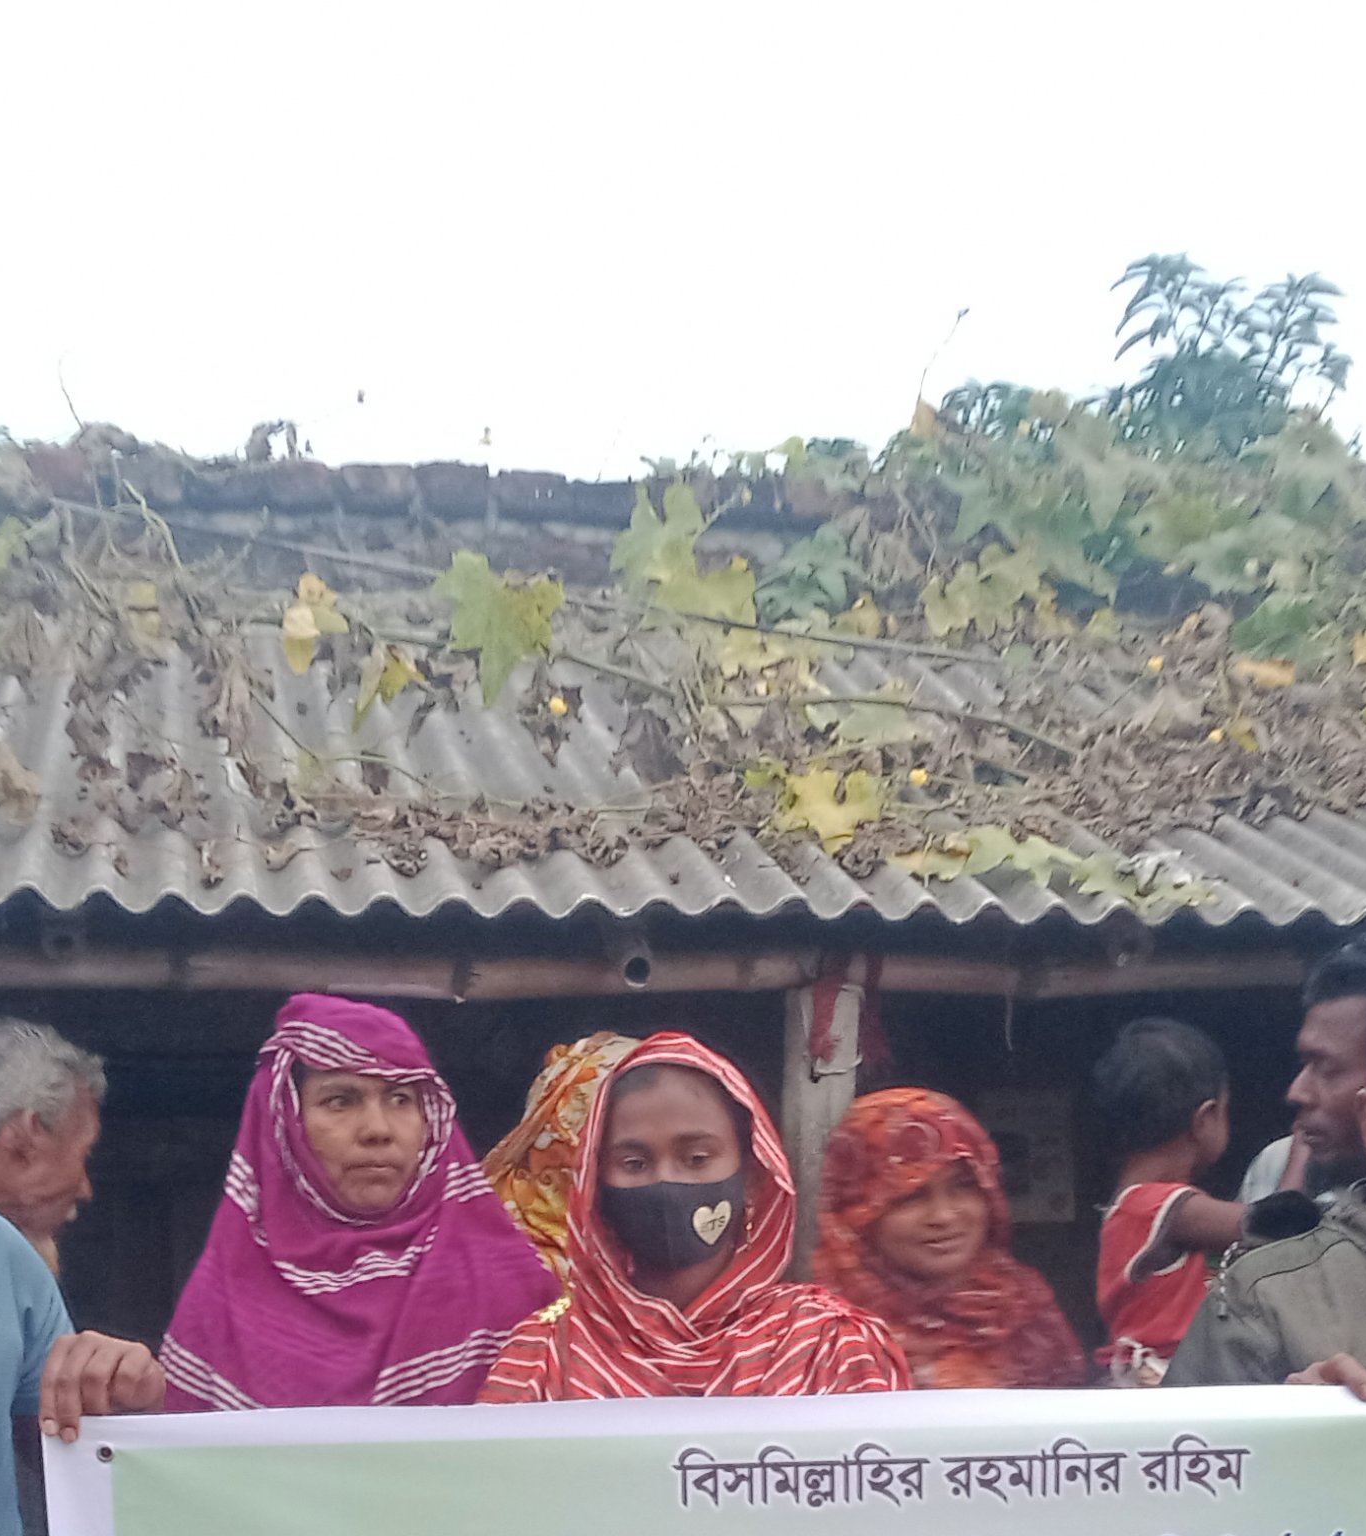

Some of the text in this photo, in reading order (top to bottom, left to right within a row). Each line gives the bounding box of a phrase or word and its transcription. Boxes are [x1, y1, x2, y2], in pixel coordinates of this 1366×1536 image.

[671, 1433, 1251, 1508] বিসমিল্লাহির রহমানির রহিম
